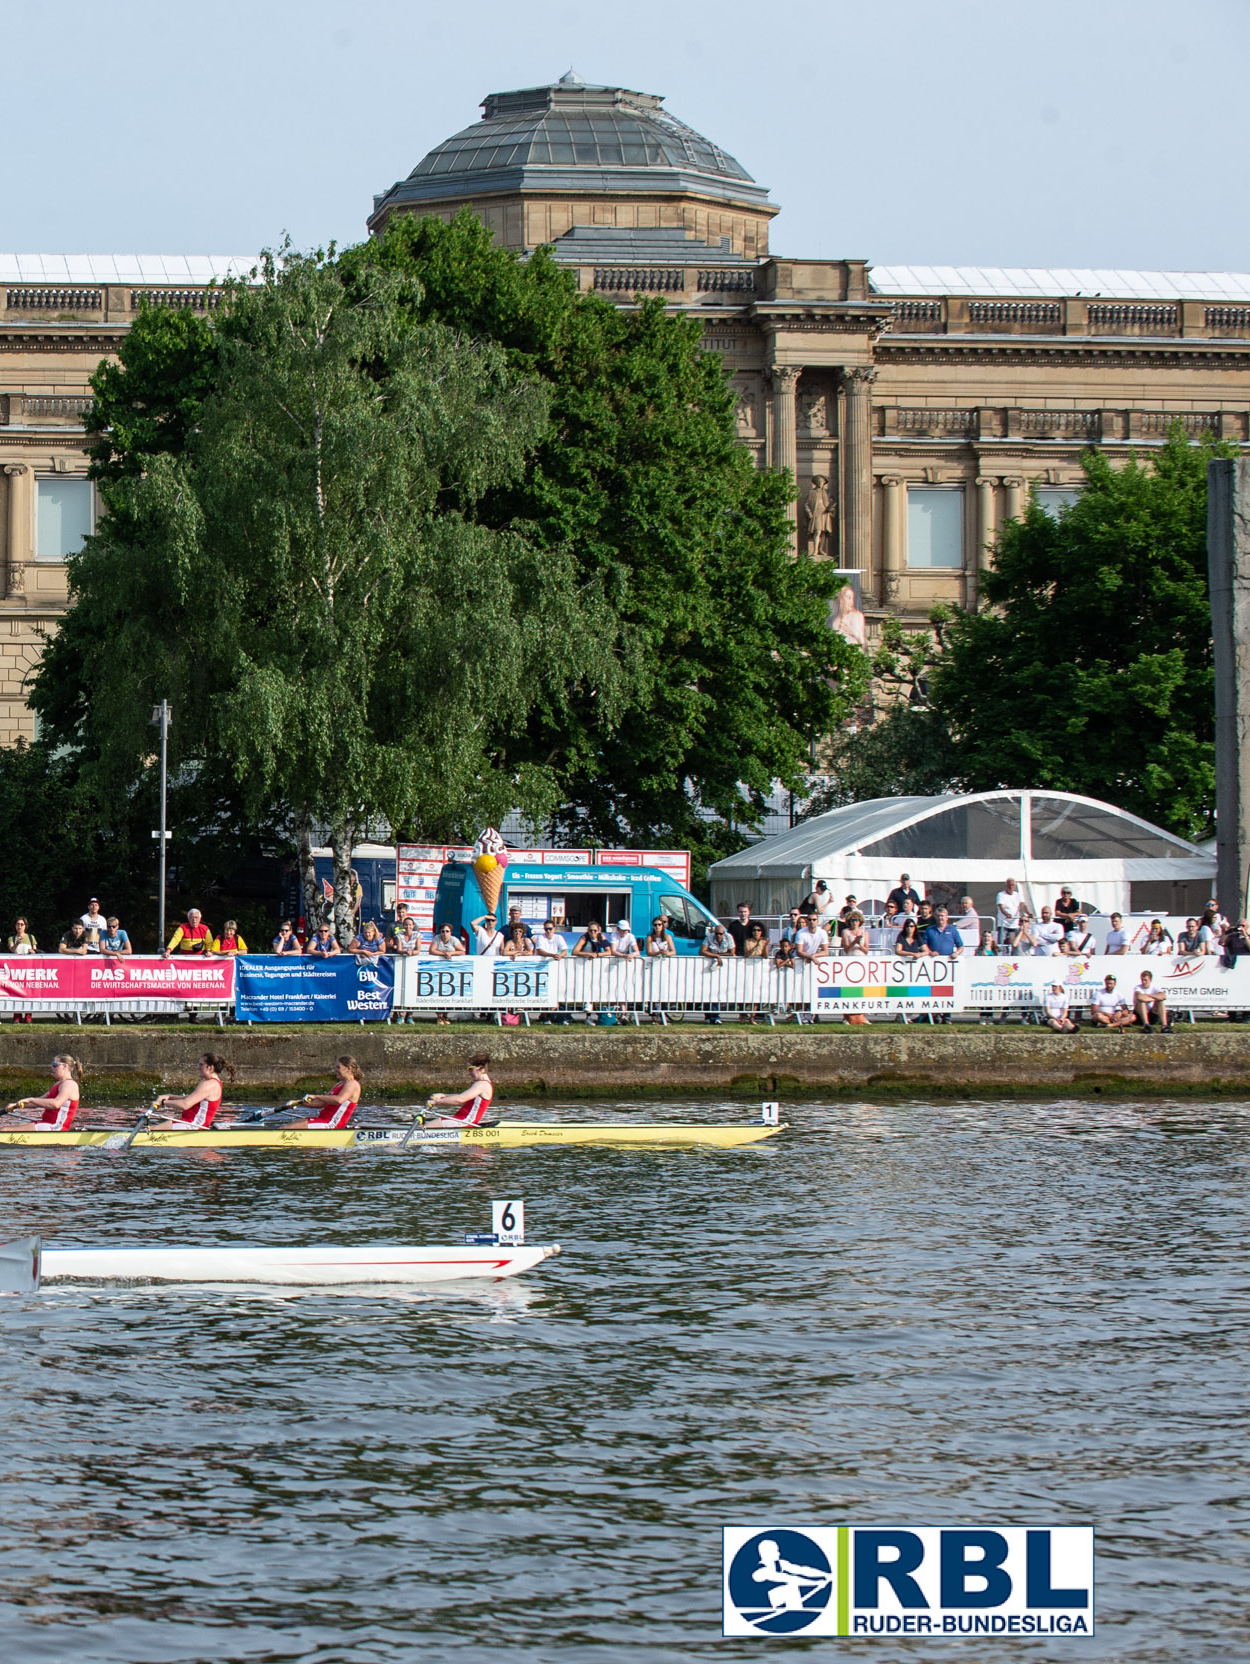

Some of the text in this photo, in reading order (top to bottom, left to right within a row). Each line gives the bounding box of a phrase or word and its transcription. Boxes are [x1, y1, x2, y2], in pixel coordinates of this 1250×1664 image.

[544, 854, 587, 862] COMMSCOPE
[525, 872, 544, 880] Frozen
[544, 873, 563, 882] Yogurt
[630, 874, 643, 882] Iced
[90, 962, 224, 982] DAS HANDWERK
[264, 964, 306, 972] Ausgangspunkt
[816, 960, 959, 984] SPORTSTADT
[359, 970, 378, 982] BW
[12, 980, 24, 988] VON
[26, 981, 60, 989] NEBENAN.
[415, 972, 474, 997] BBF
[490, 972, 548, 997] BBF
[358, 990, 382, 1000] Best
[970, 990, 993, 1000] TITUS
[998, 990, 1034, 1000] THERMEN
[1161, 988, 1228, 996] SYSTEM GMBH
[817, 1001, 890, 1010] FRANKFURT
[922, 1000, 954, 1009] MAIN
[766, 1104, 772, 1118] 1
[392, 1131, 460, 1140] RUDR-BUNDESLIGA
[502, 1202, 516, 1232] 6
